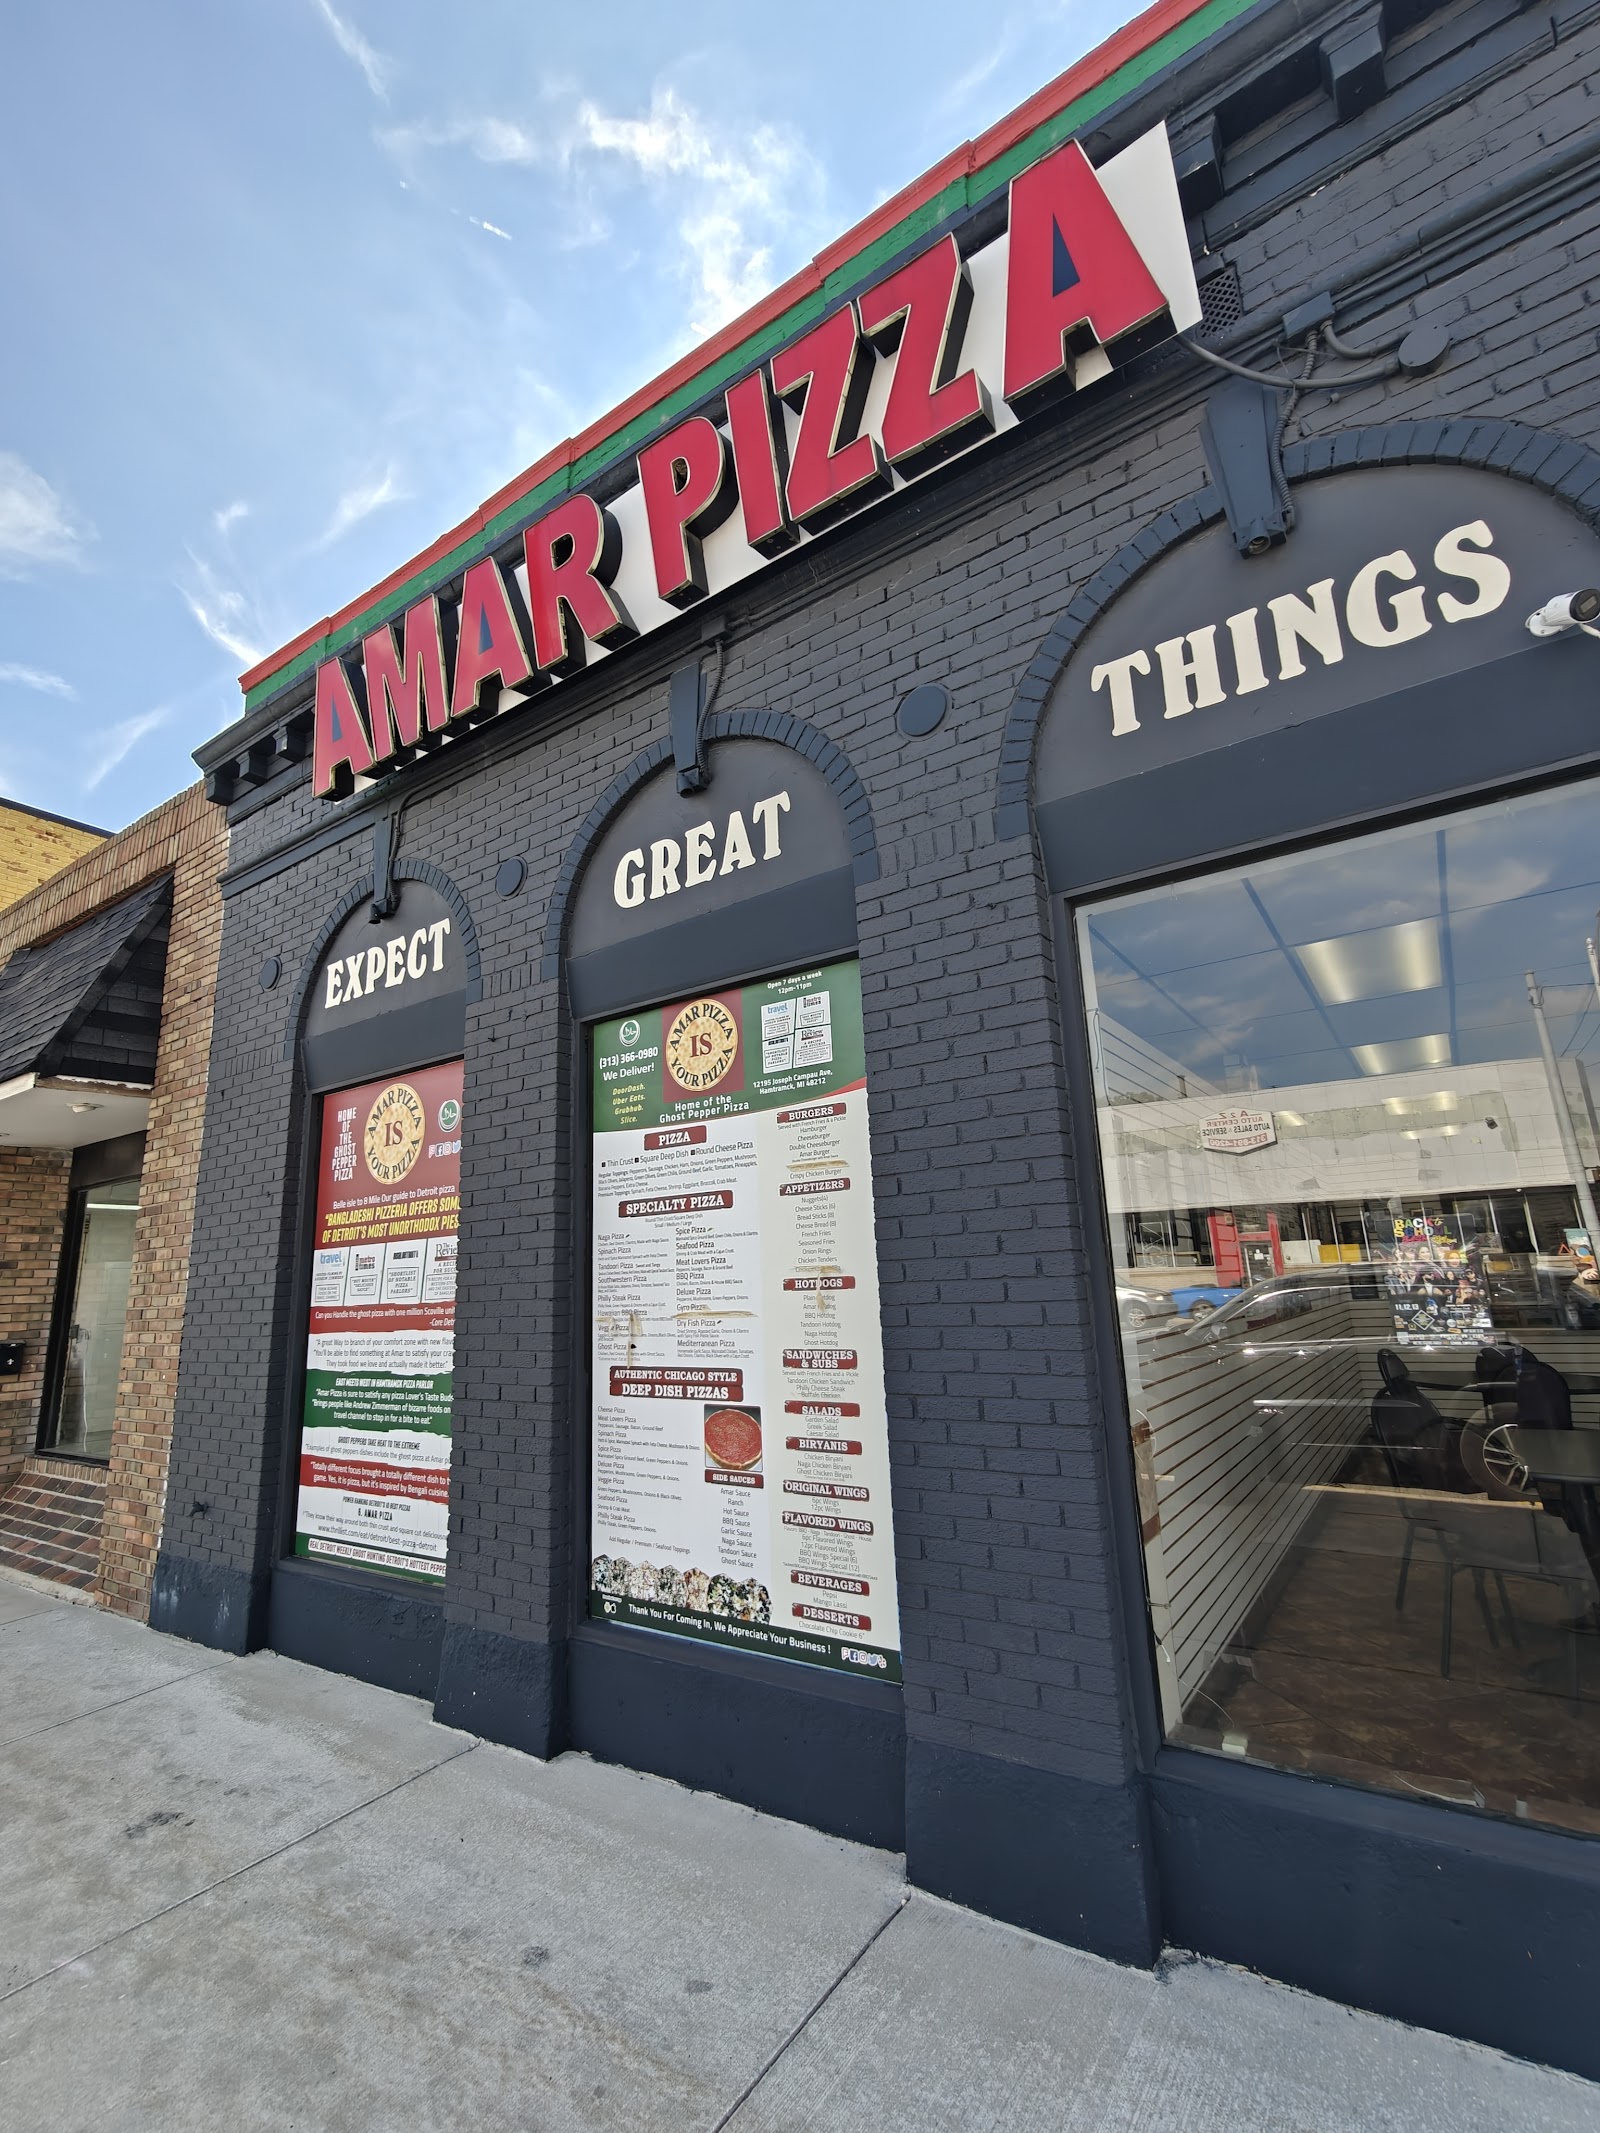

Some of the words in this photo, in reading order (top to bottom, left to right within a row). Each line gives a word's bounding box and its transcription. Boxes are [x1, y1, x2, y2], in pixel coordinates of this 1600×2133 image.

[313, 494, 634, 799] AMAR
[637, 138, 1174, 600] PIZZA
[1090, 519, 1511, 736] THINGS
[613, 791, 791, 909] GREAT
[324, 918, 451, 1009] EXPECT
[767, 980, 782, 989] Open
[787, 976, 801, 985] days
[806, 971, 822, 980] week
[778, 982, 812, 994] 12pm-11pm
[767, 1003, 788, 1014] travel
[669, 1005, 700, 1051] AMAR
[702, 1003, 734, 1041] PIZZA
[801, 1029, 823, 1038] Review
[690, 1032, 713, 1058] IS
[600, 1055, 619, 1069] (313)
[620, 1047, 658, 1064] 366-0980
[603, 1070, 618, 1081] We
[620, 1062, 655, 1078] Deliver!
[671, 1058, 699, 1087] YOUR
[702, 1047, 734, 1086] PIZZA
[753, 1079, 771, 1088] 12195
[772, 1075, 793, 1086] Joseph
[793, 1071, 818, 1082] Campau
[759, 1083, 795, 1095] Hamtramck,
[797, 1080, 805, 1088] MI
[806, 1077, 826, 1086] 48212
[612, 1083, 646, 1095] DoorDash.
[612, 1097, 628, 1106] Uber
[630, 1094, 646, 1103] Eats.
[675, 1101, 700, 1111] Home
[703, 1097, 713, 1106] of
[716, 1095, 732, 1104] the
[337, 1107, 357, 1122] HOME
[368, 1090, 395, 1138] AMAR
[397, 1088, 422, 1130] PIZZA
[614, 1105, 644, 1115] Grubhub.
[659, 1111, 686, 1123] Ghost
[688, 1106, 720, 1120] Pepper
[724, 1102, 750, 1114] Pizza
[788, 1106, 834, 1121] BURGERS
[342, 1121, 351, 1133] OF
[620, 1116, 638, 1125] Slice.
[384, 1120, 403, 1147] IS
[800, 1124, 827, 1133] Hamburger
[340, 1132, 352, 1145] THE
[658, 1131, 691, 1146] PIZZA
[797, 1132, 831, 1142] Cheeseburger
[334, 1143, 356, 1158] GHOST
[620, 1158, 634, 1166] Crust
[639, 1155, 659, 1164] Square
[660, 1152, 675, 1160] Deep
[676, 1149, 689, 1158] Dish
[695, 1145, 714, 1155] Round
[715, 1143, 736, 1153] Cheese
[737, 1141, 753, 1150] Pizza
[332, 1155, 357, 1170] PEPPER
[367, 1146, 390, 1180] YOUR
[392, 1138, 422, 1180] PIZZA
[334, 1167, 353, 1182] PIZZA
[785, 1180, 844, 1194] APPETIZERS
[333, 1200, 346, 1210] Belle
[347, 1199, 356, 1207] isle
[357, 1198, 363, 1207] to
[363, 1197, 368, 1205] 8
[368, 1195, 381, 1204] Mile
[381, 1194, 392, 1203] Our
[392, 1190, 409, 1202] guide
[409, 1189, 416, 1199] to
[417, 1186, 439, 1198] Detroit
[439, 1185, 456, 1197] pizza
[626, 1198, 687, 1215] SPECIALTY
[690, 1194, 724, 1209] PIZZA
[375, 1203, 408, 1220] PIZZERIA
[409, 1199, 439, 1215] OFFERS
[322, 1231, 332, 1243] OF
[332, 1224, 367, 1242] DETROIT'S
[367, 1222, 389, 1237] MOST
[389, 1216, 439, 1236] UNORTHODOX
[675, 1227, 690, 1235] Spice
[691, 1226, 706, 1234] Pizza
[1394, 1218, 1434, 1229] BACK
[1434, 1217, 1444, 1226] to
[1394, 1226, 1452, 1237] SCHOOL
[436, 1243, 458, 1257] Revie
[675, 1242, 698, 1250] Seafood
[699, 1241, 715, 1249] Pizza
[320, 1250, 342, 1264] travel
[795, 1278, 843, 1289] HOTDOGS
[677, 1340, 719, 1348] Mediterranean
[719, 1339, 735, 1347] Pizza
[786, 1350, 853, 1360] SANDWICHES
[801, 1360, 809, 1368] &
[812, 1360, 838, 1368] SUBS
[614, 1369, 663, 1380] AUTHENTIC
[664, 1371, 705, 1381] CHICAGO
[708, 1372, 738, 1382] STYLE
[622, 1383, 651, 1396] DEEP
[654, 1384, 683, 1397] DISH
[686, 1385, 729, 1400] PIZZAS
[801, 1405, 842, 1416] SALADS
[799, 1439, 848, 1451] BIRYANIS
[712, 1473, 728, 1482] SIDE
[729, 1474, 756, 1485] SAUCES
[785, 1480, 832, 1495] ORIGINAL
[834, 1486, 867, 1498] WINGS
[364, 1509, 378, 1519] AMAR
[379, 1510, 393, 1521] PIZZA
[784, 1512, 836, 1528] FLAVORED
[838, 1519, 872, 1532] WINGS
[309, 1540, 320, 1550] REAL
[320, 1541, 336, 1553] DETROIT
[337, 1544, 352, 1555] WEEKLY
[352, 1547, 366, 1558] GHOST
[367, 1550, 386, 1563] HUNTING
[386, 1553, 409, 1567] DETROIT'S
[409, 1557, 429, 1571] HOTTEST
[430, 1561, 446, 1575] PEPPE
[797, 1573, 862, 1593] BEVERAGES
[803, 1606, 860, 1626] DESSERTS
[628, 1603, 649, 1616] Thank
[649, 1606, 662, 1619] You
[663, 1610, 675, 1621] For
[675, 1613, 702, 1629] Coming
[703, 1618, 712, 1631] In,
[714, 1620, 727, 1632] We
[727, 1623, 768, 1641] Appreciate
[769, 1633, 787, 1645] Your
[789, 1637, 826, 1654] Business
